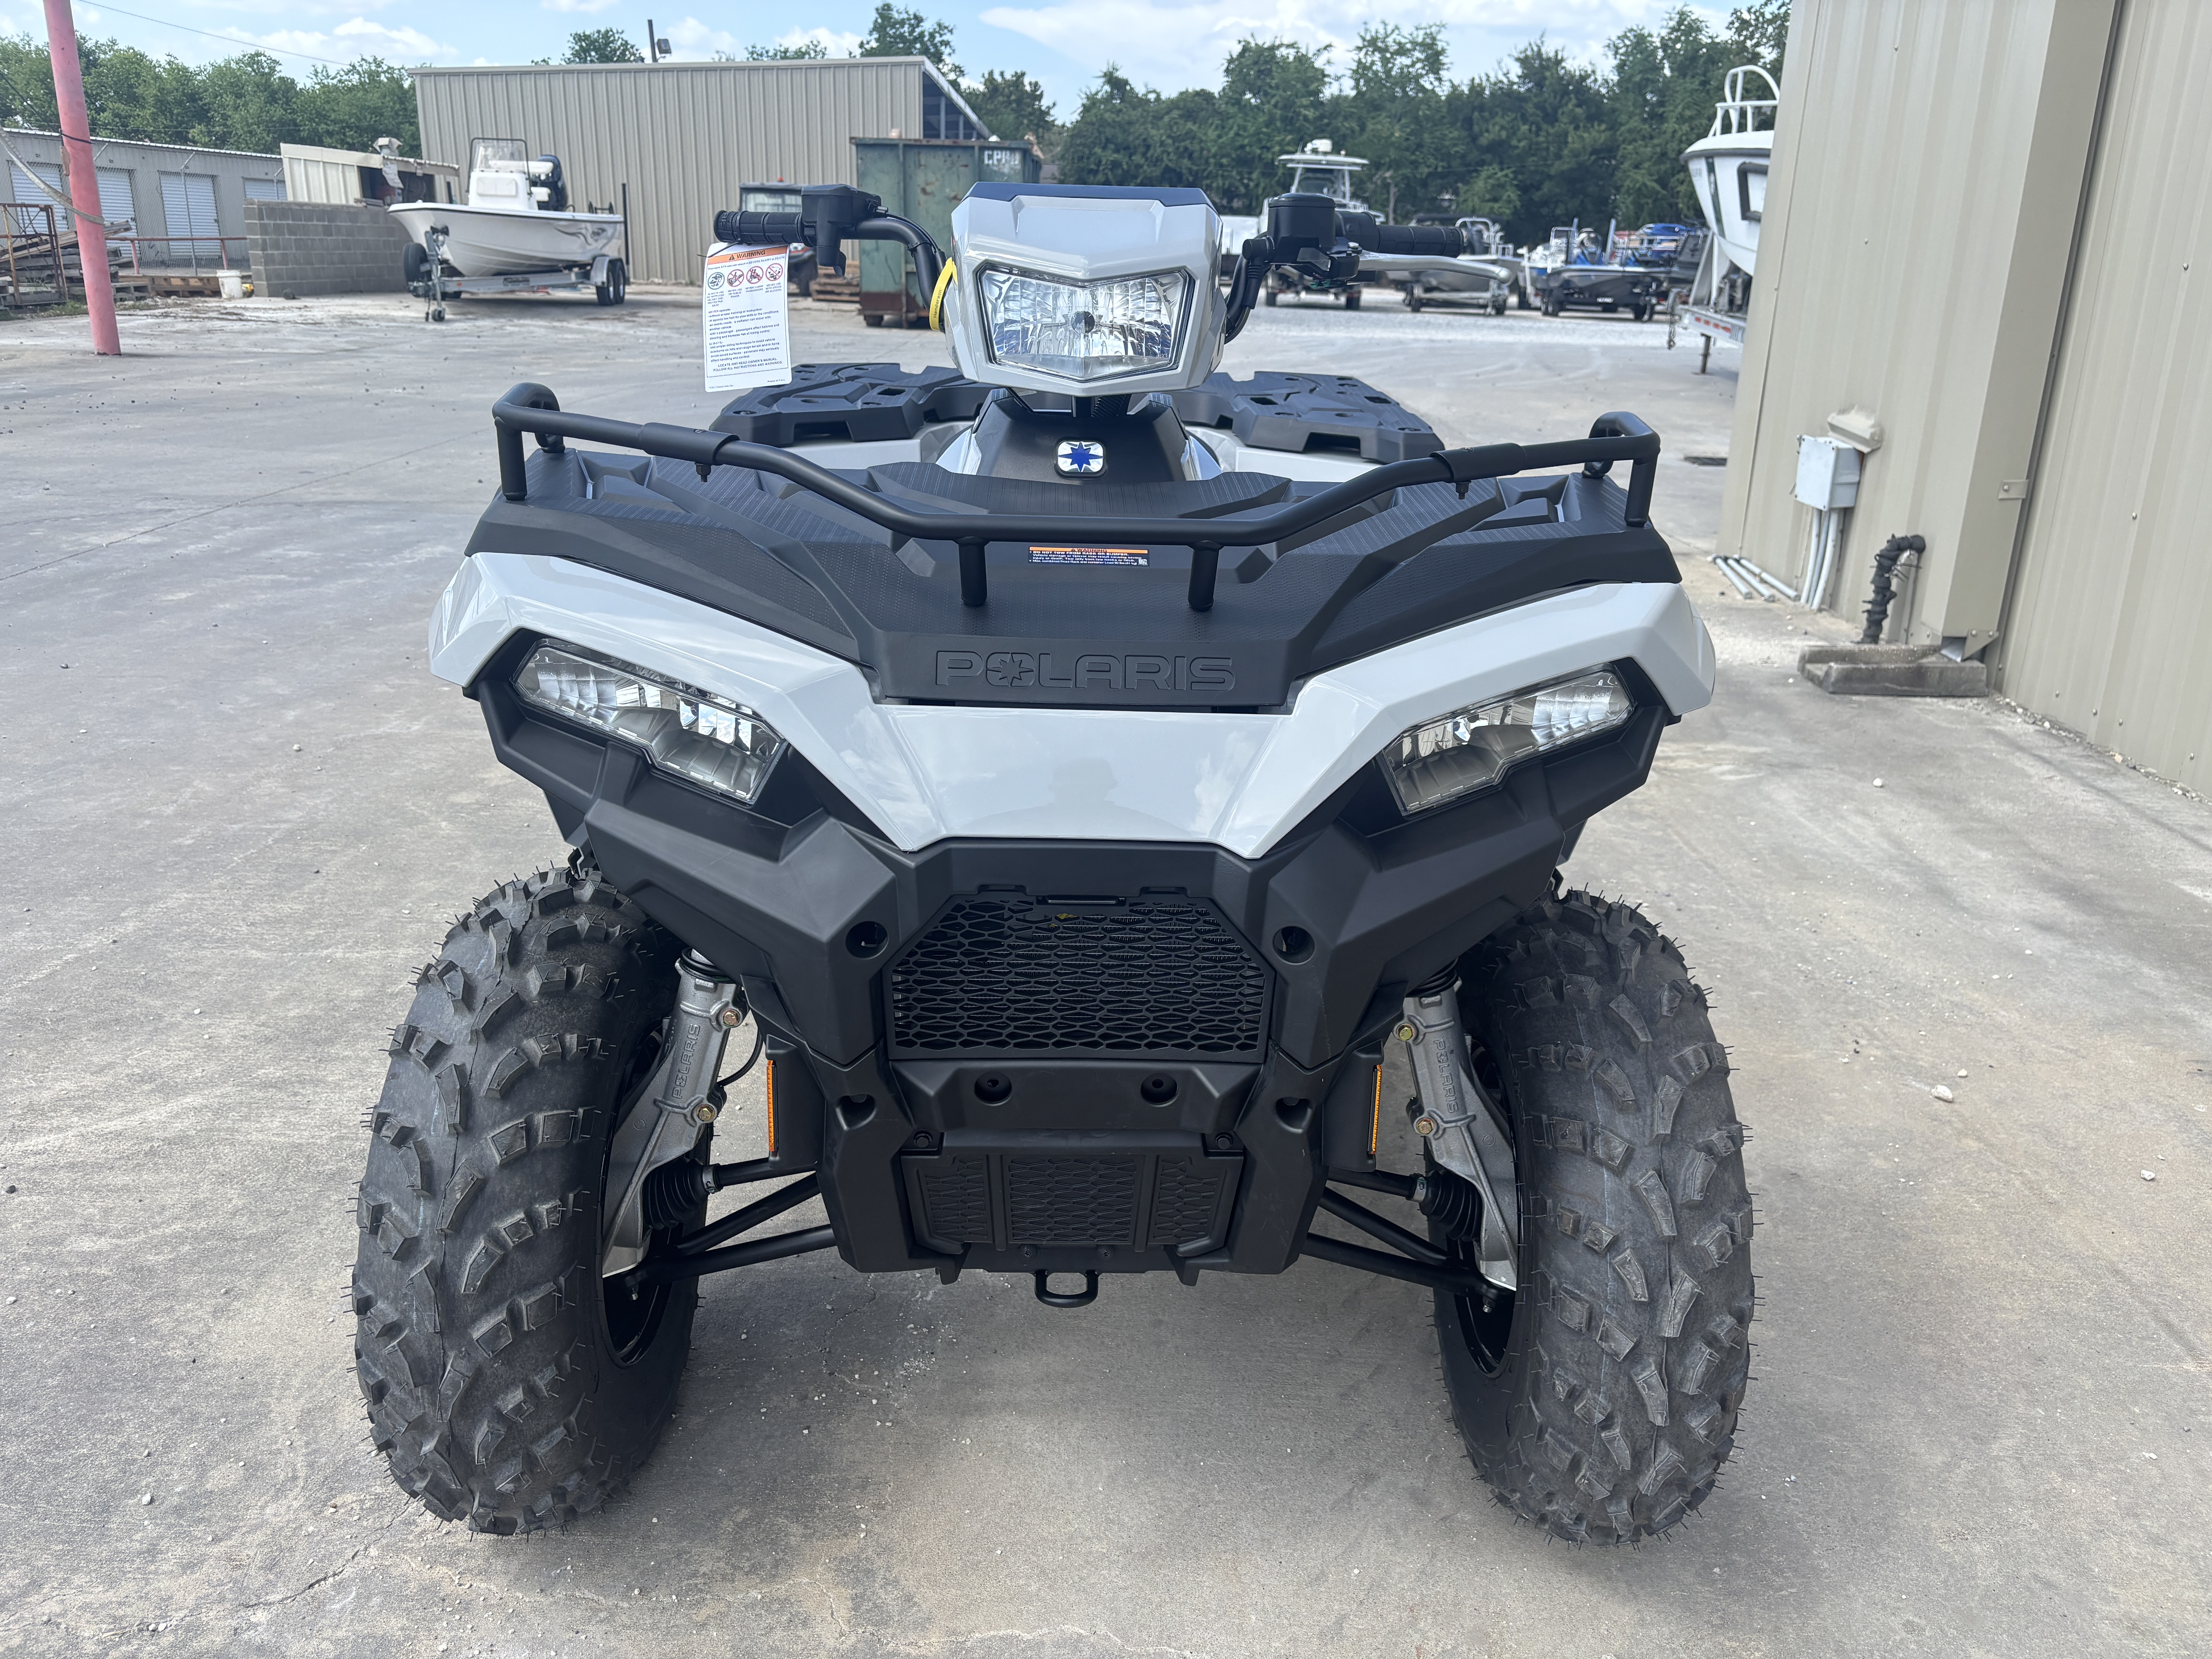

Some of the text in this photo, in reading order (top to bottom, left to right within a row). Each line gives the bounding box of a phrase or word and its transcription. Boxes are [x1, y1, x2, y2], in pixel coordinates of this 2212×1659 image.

[737, 250, 766, 259] WARNING
[935, 651, 1236, 692] POLARIS
[672, 1024, 700, 1099] POLARIS
[1434, 1039, 1459, 1113] POLARIS
